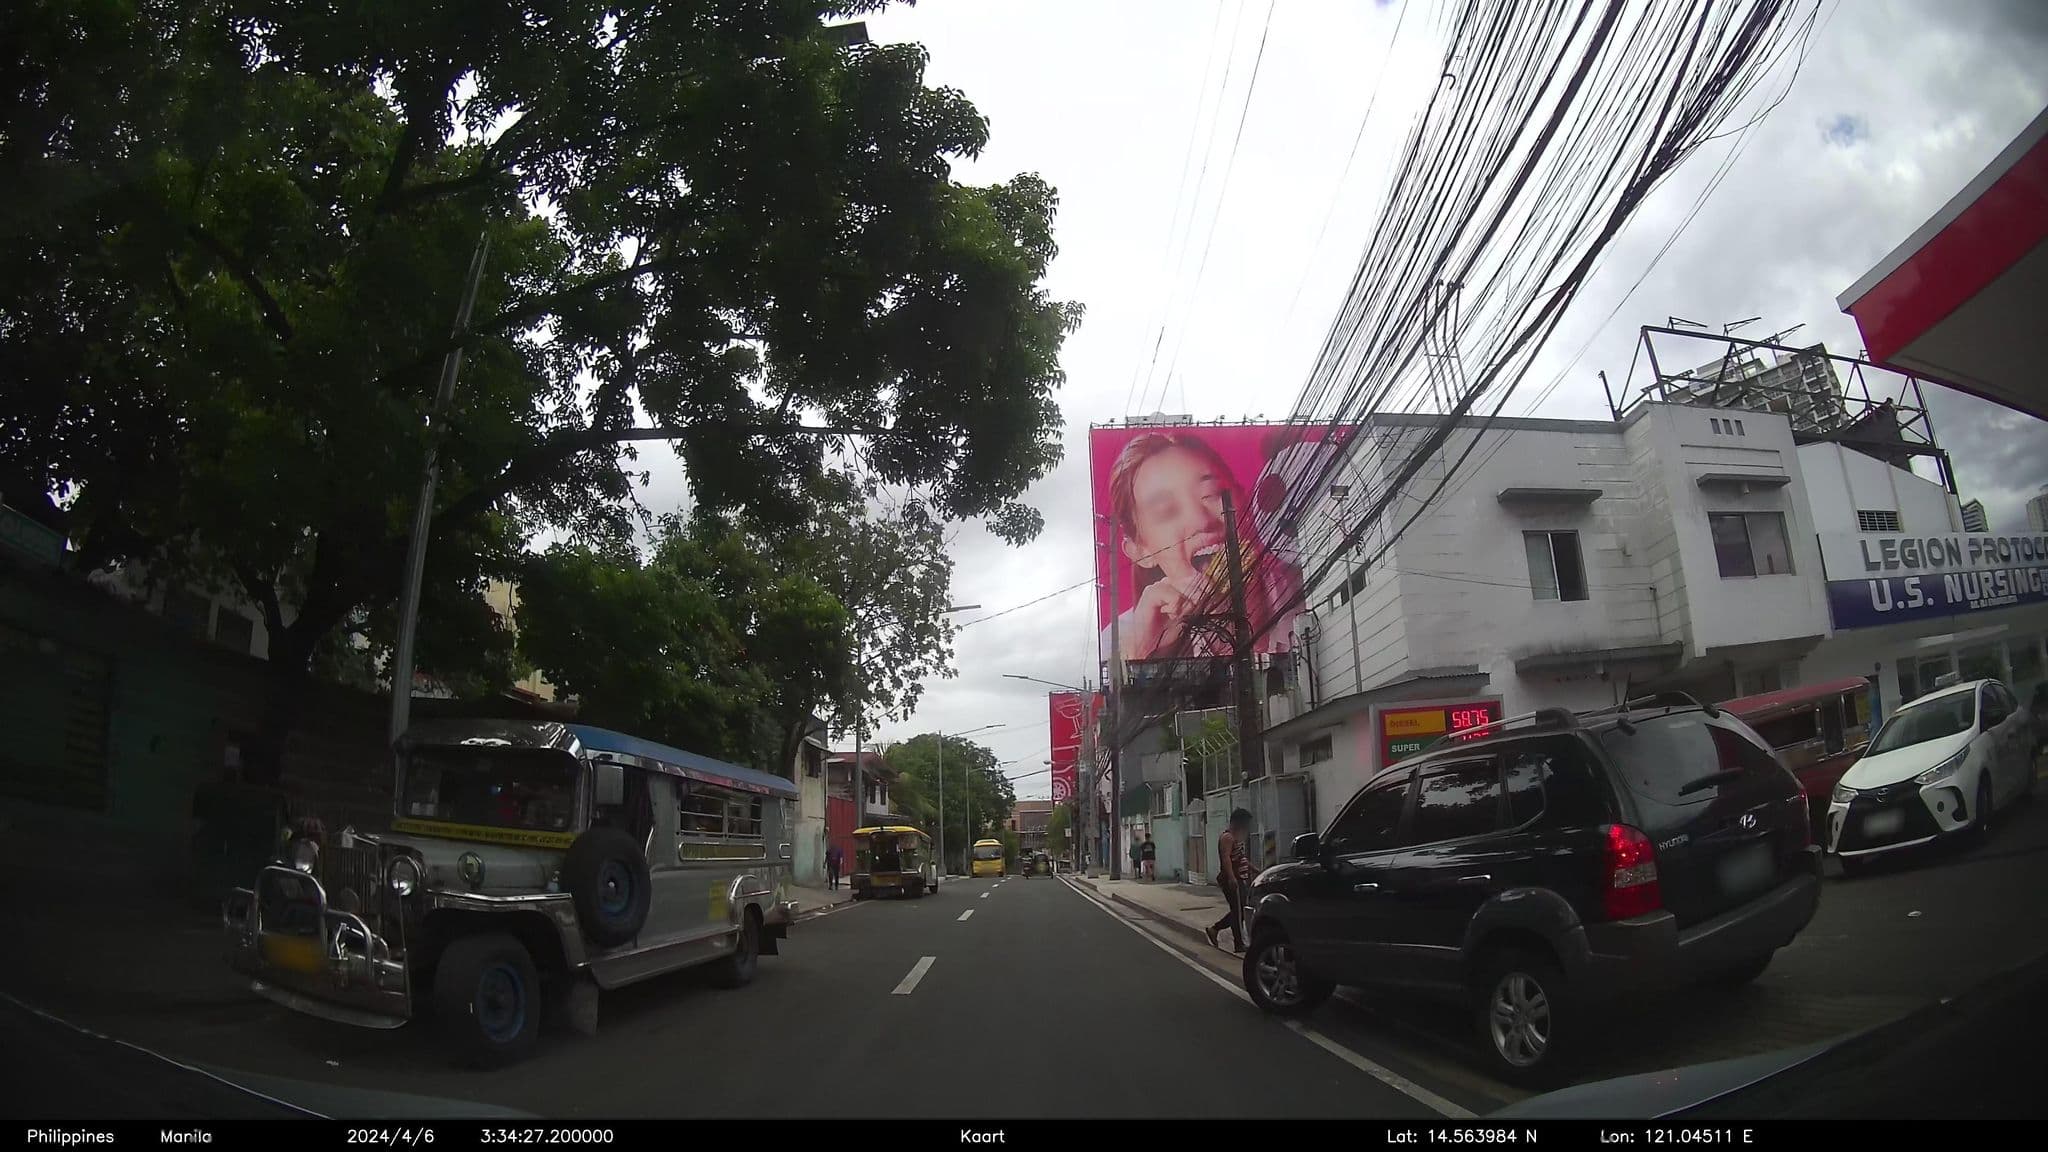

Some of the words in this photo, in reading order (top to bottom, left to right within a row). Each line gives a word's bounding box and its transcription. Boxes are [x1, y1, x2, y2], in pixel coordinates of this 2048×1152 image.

[1860, 537, 1963, 572] LEGION
[1967, 535, 2048, 565] PROTOC
[1868, 576, 1934, 613] U.S.
[1943, 567, 2042, 604] NURSING
[1391, 743, 1421, 753] SUPER
